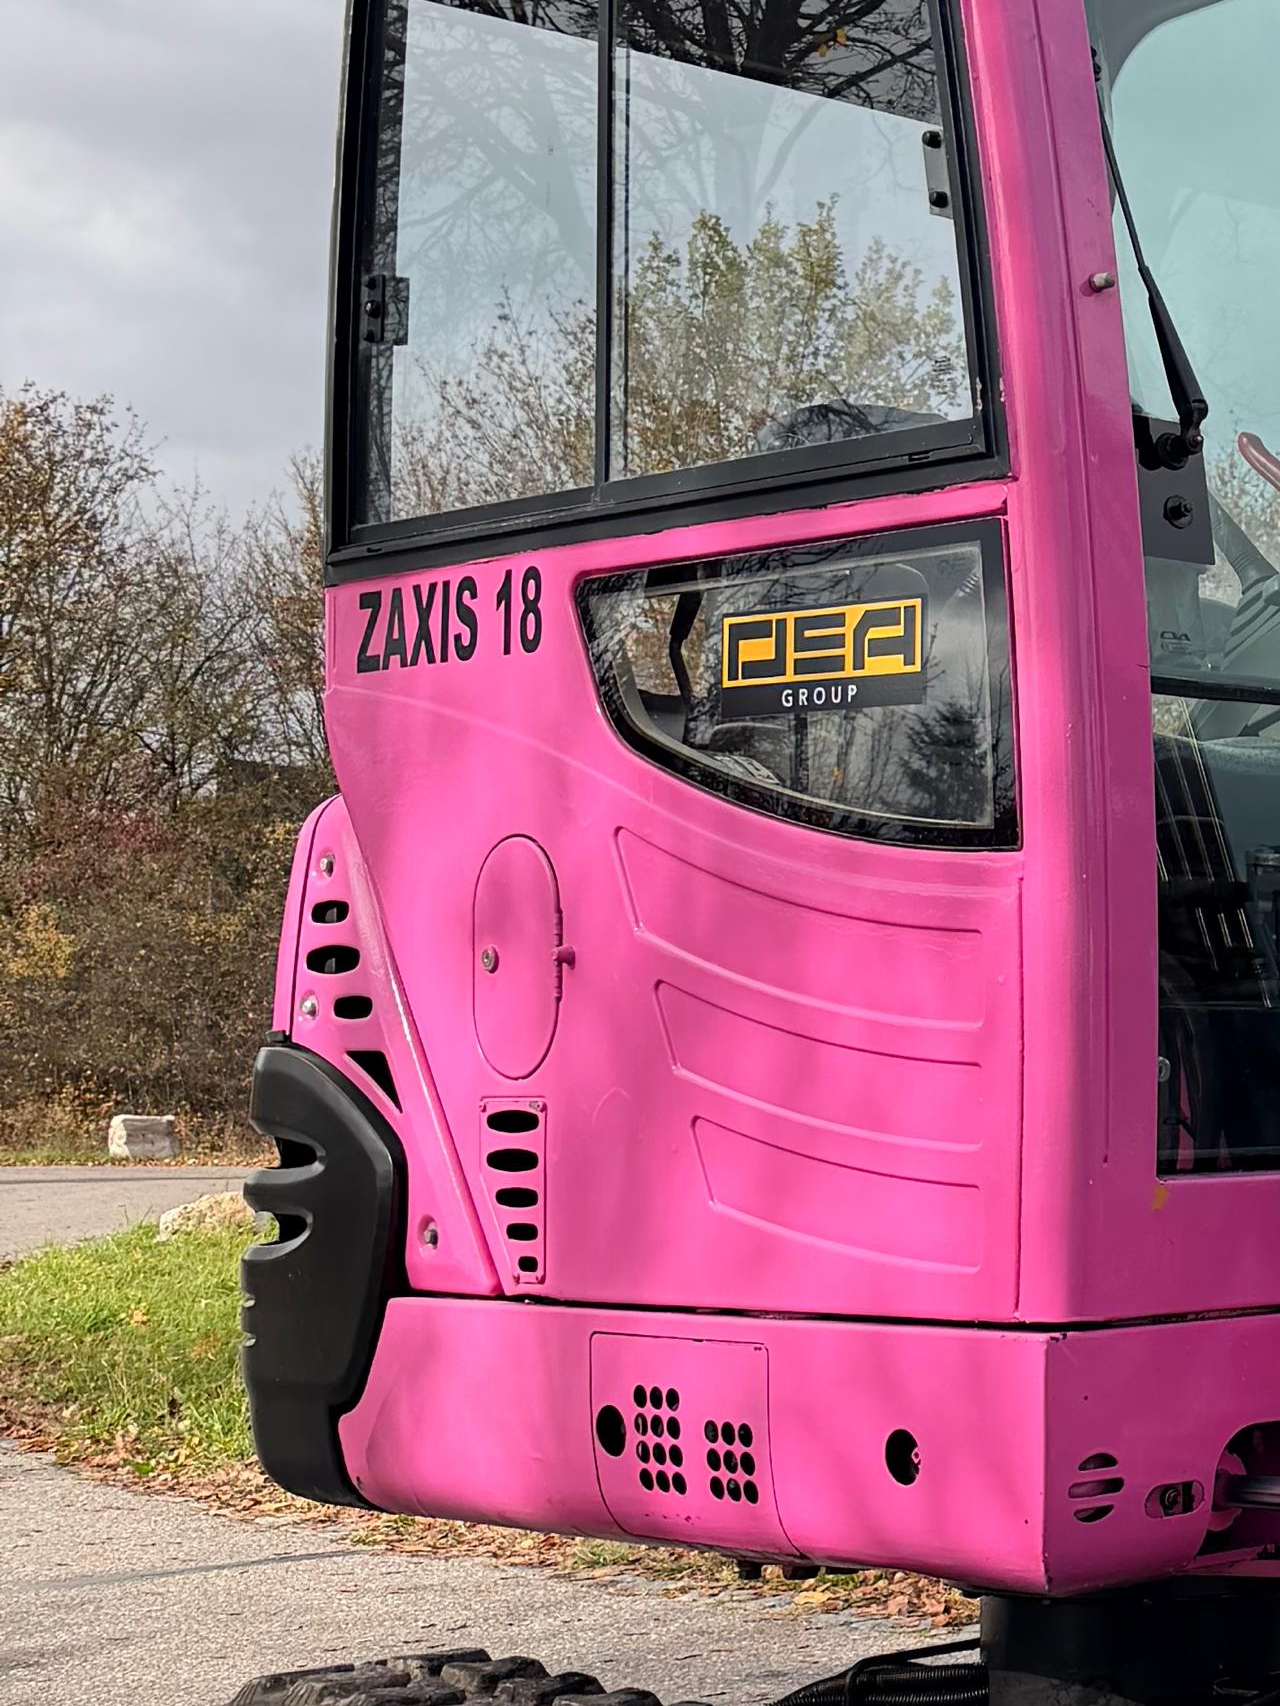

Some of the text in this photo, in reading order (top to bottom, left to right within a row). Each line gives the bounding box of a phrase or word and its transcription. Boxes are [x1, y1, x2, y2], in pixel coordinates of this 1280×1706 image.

[356, 565, 542, 675] ZAXIS 18
[781, 684, 858, 707] GROUP
